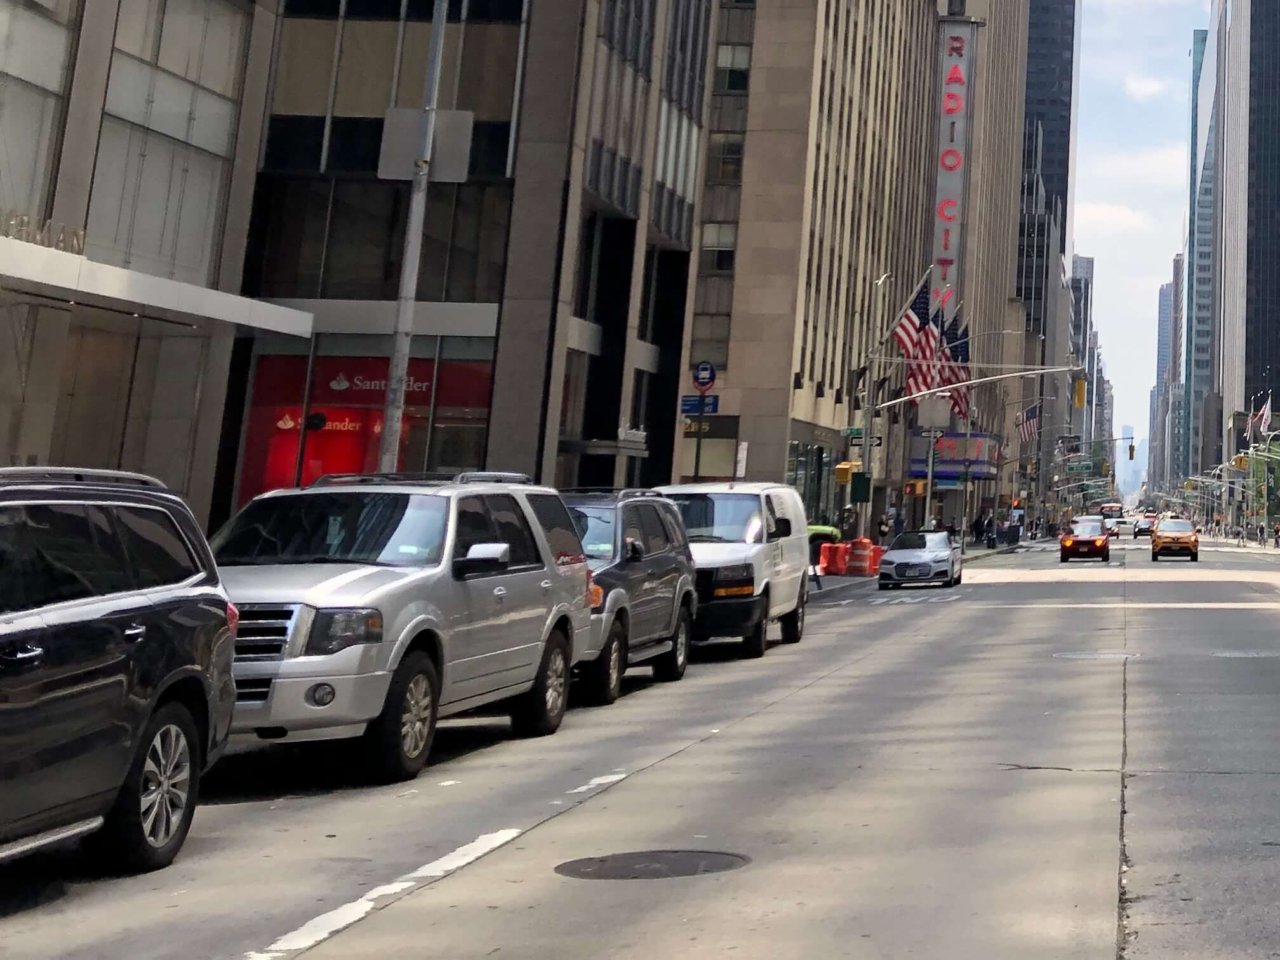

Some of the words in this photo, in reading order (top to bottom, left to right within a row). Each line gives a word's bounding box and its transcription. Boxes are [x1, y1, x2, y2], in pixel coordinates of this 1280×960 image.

[940, 35, 965, 172] RADIO
[933, 199, 958, 310] CITY
[352, 376, 430, 391] Santder
[296, 417, 361, 431] Sander
